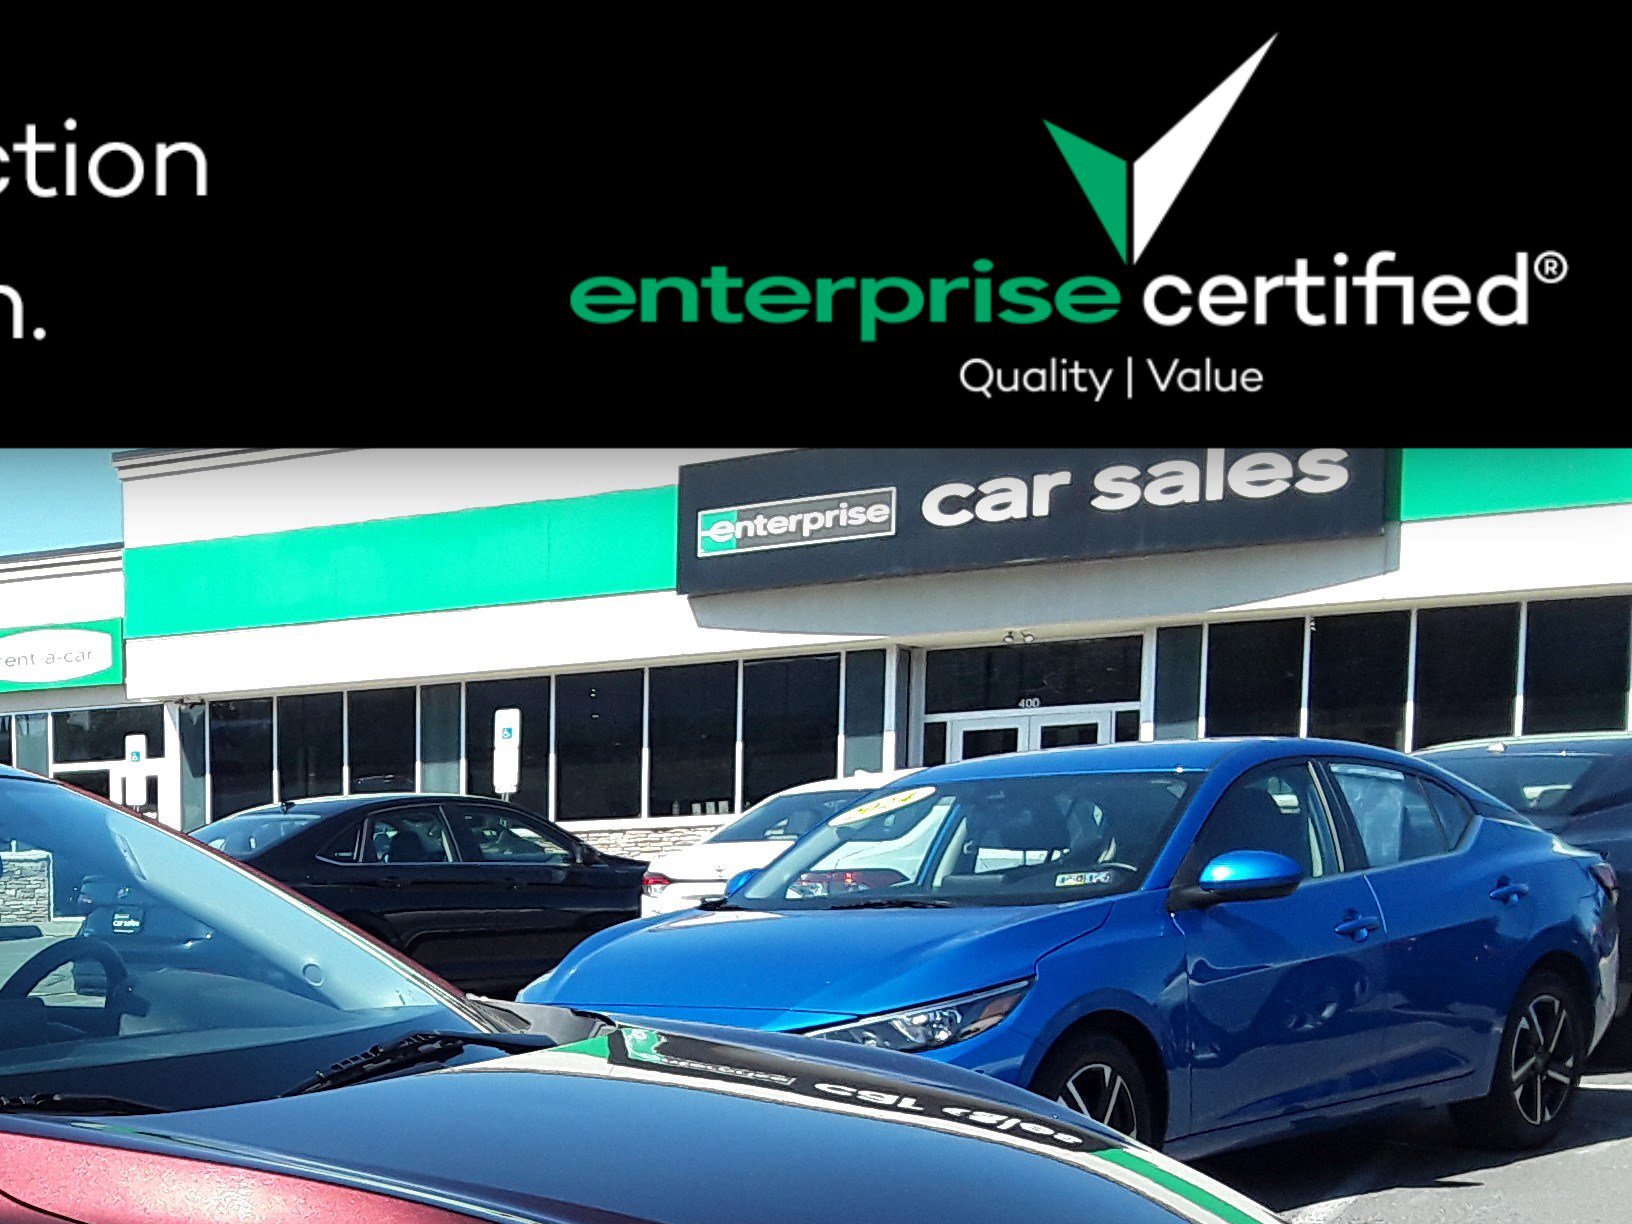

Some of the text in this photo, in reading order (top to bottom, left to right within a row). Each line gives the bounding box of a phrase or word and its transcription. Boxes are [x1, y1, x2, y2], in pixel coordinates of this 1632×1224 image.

[702, 447, 1350, 543] enterprise car sales
[1017, 697, 1042, 709] 400
